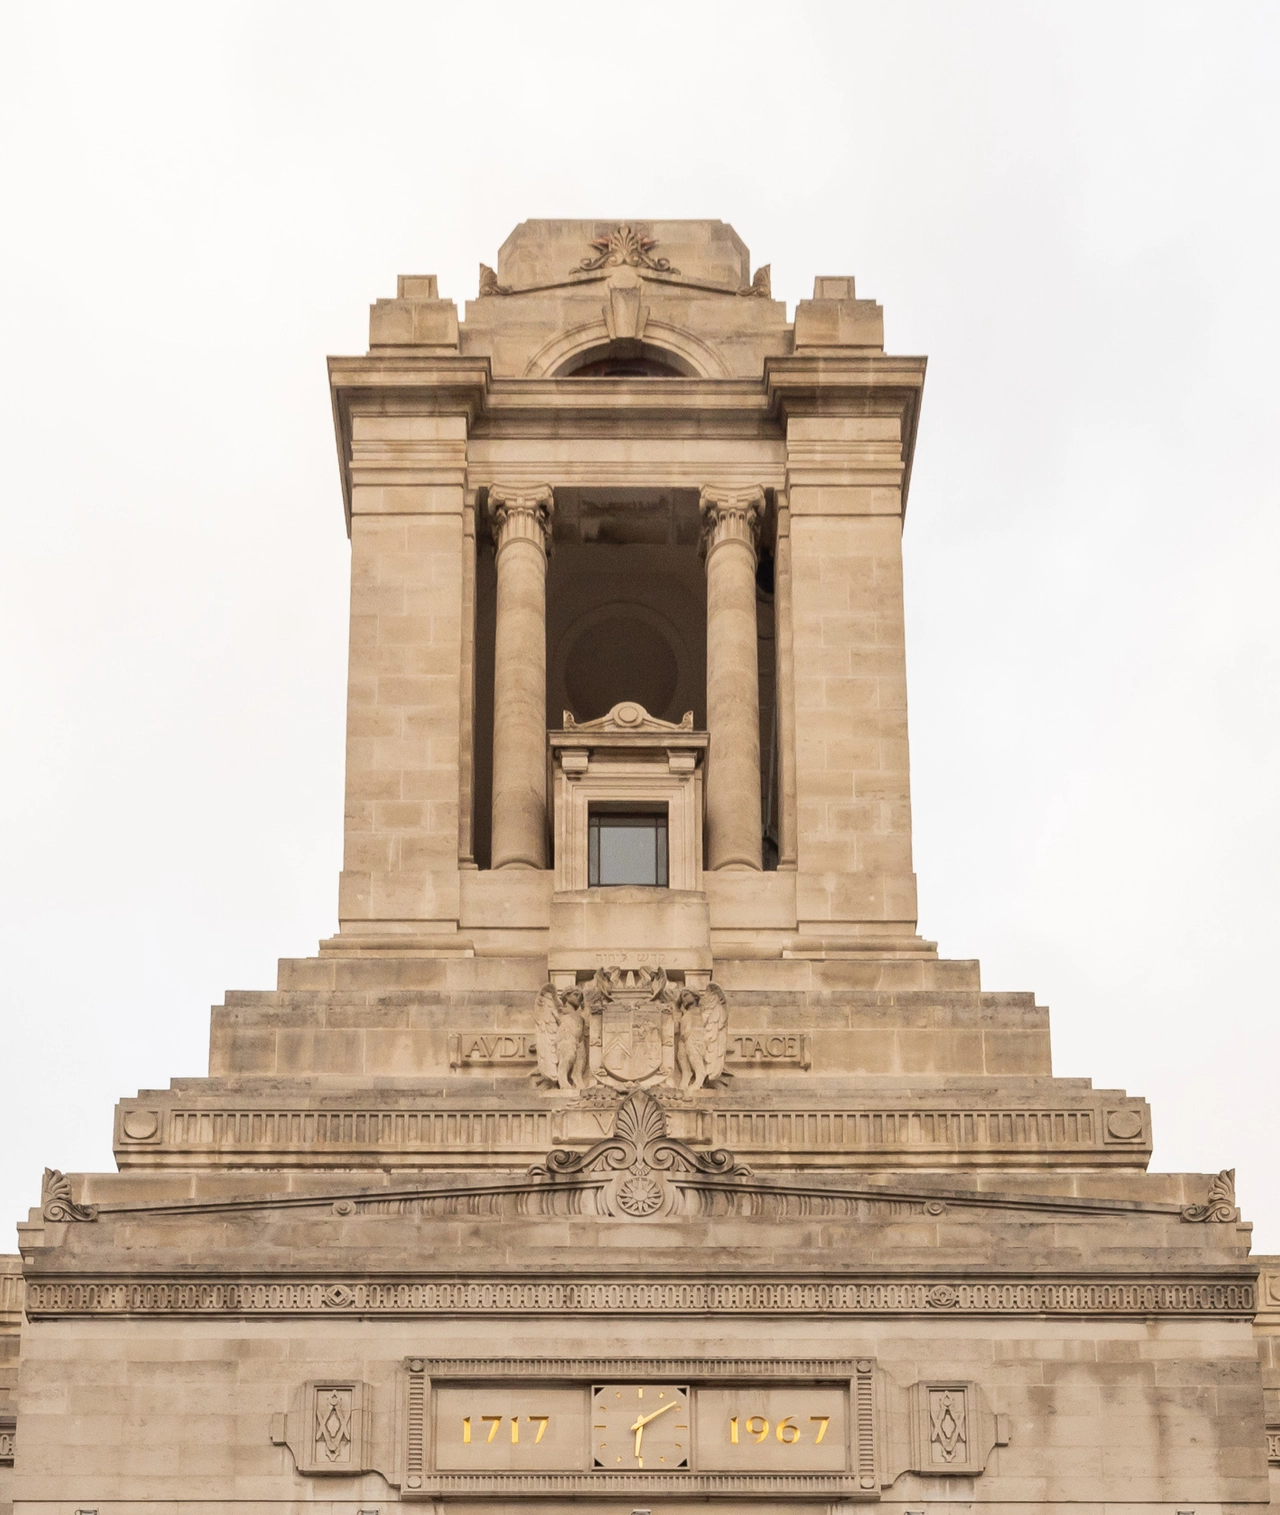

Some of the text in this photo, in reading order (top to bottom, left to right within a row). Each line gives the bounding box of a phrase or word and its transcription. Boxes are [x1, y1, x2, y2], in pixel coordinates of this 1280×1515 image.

[465, 1036, 526, 1058] AVDI
[734, 1037, 797, 1058] TACE
[463, 1415, 549, 1444] 1717
[730, 1415, 830, 1444] 1967
